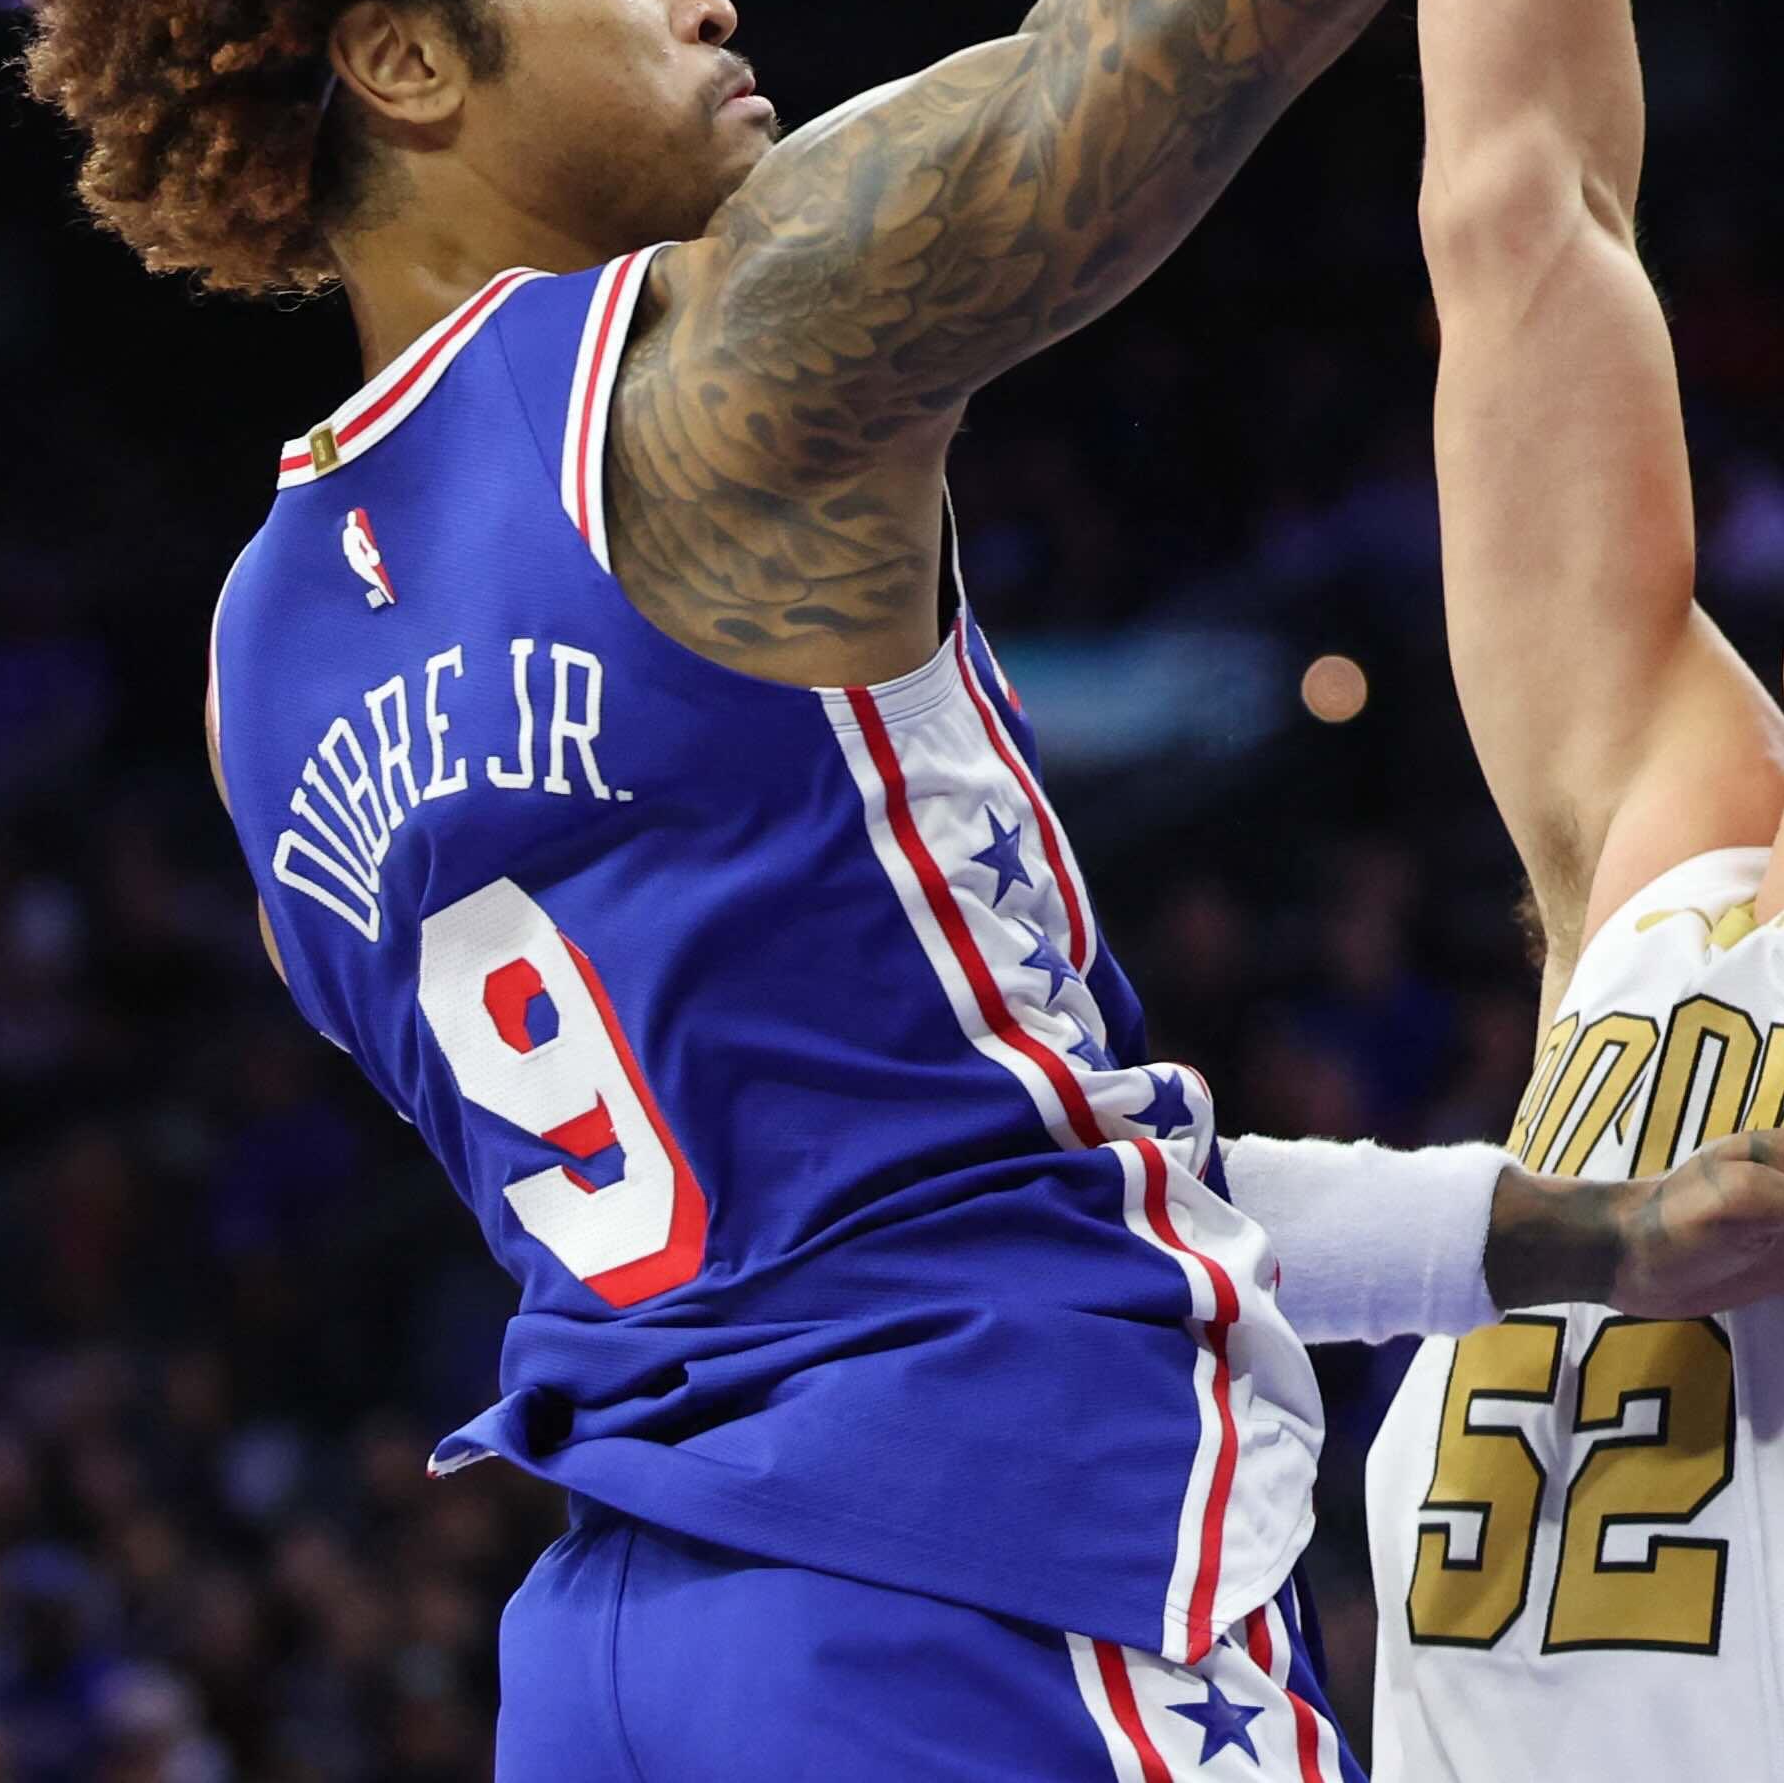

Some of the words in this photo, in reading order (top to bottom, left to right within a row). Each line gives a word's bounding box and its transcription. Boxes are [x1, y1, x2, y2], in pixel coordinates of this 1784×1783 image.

[273, 645, 468, 943] OUBRE
[487, 638, 633, 802] JR.
[418, 877, 708, 1309] 9
[1406, 1314, 1734, 1655] 52
